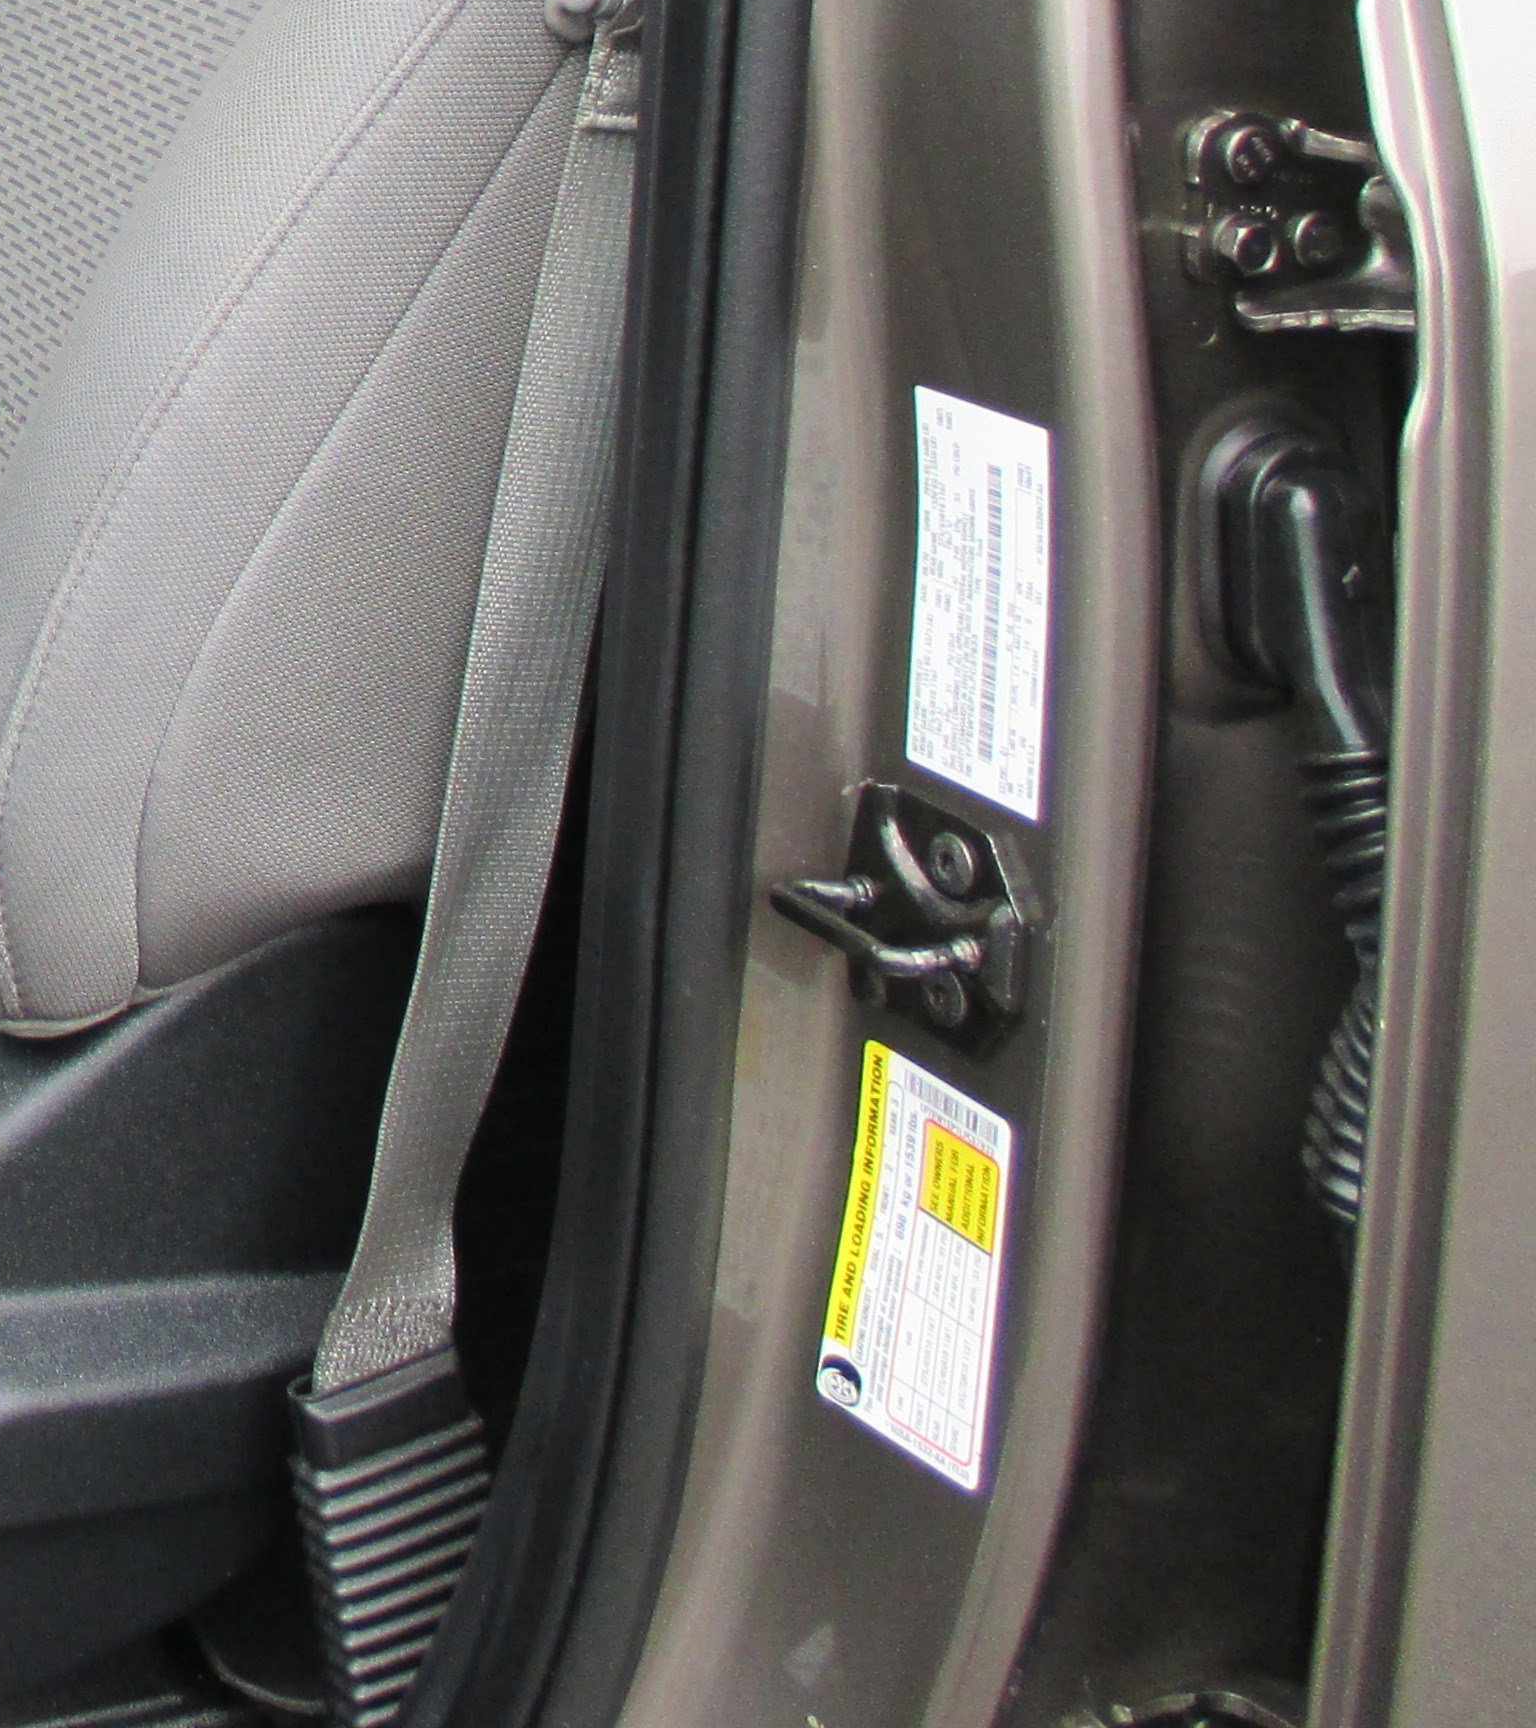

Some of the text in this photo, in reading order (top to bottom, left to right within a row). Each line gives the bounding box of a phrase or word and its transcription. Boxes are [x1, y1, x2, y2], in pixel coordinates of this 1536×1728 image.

[903, 1171, 913, 1189] or
[904, 1132, 916, 1169] 1539
[928, 1138, 944, 1214] SEE OWNERS
[834, 1052, 883, 1344] TIRE AND LOADING INFORMATION
[899, 1187, 912, 1209] kg
[943, 1174, 957, 1224] MANUAL
[960, 1160, 975, 1231] ADDITIONAL
[975, 1162, 991, 1245] INFORMATION
